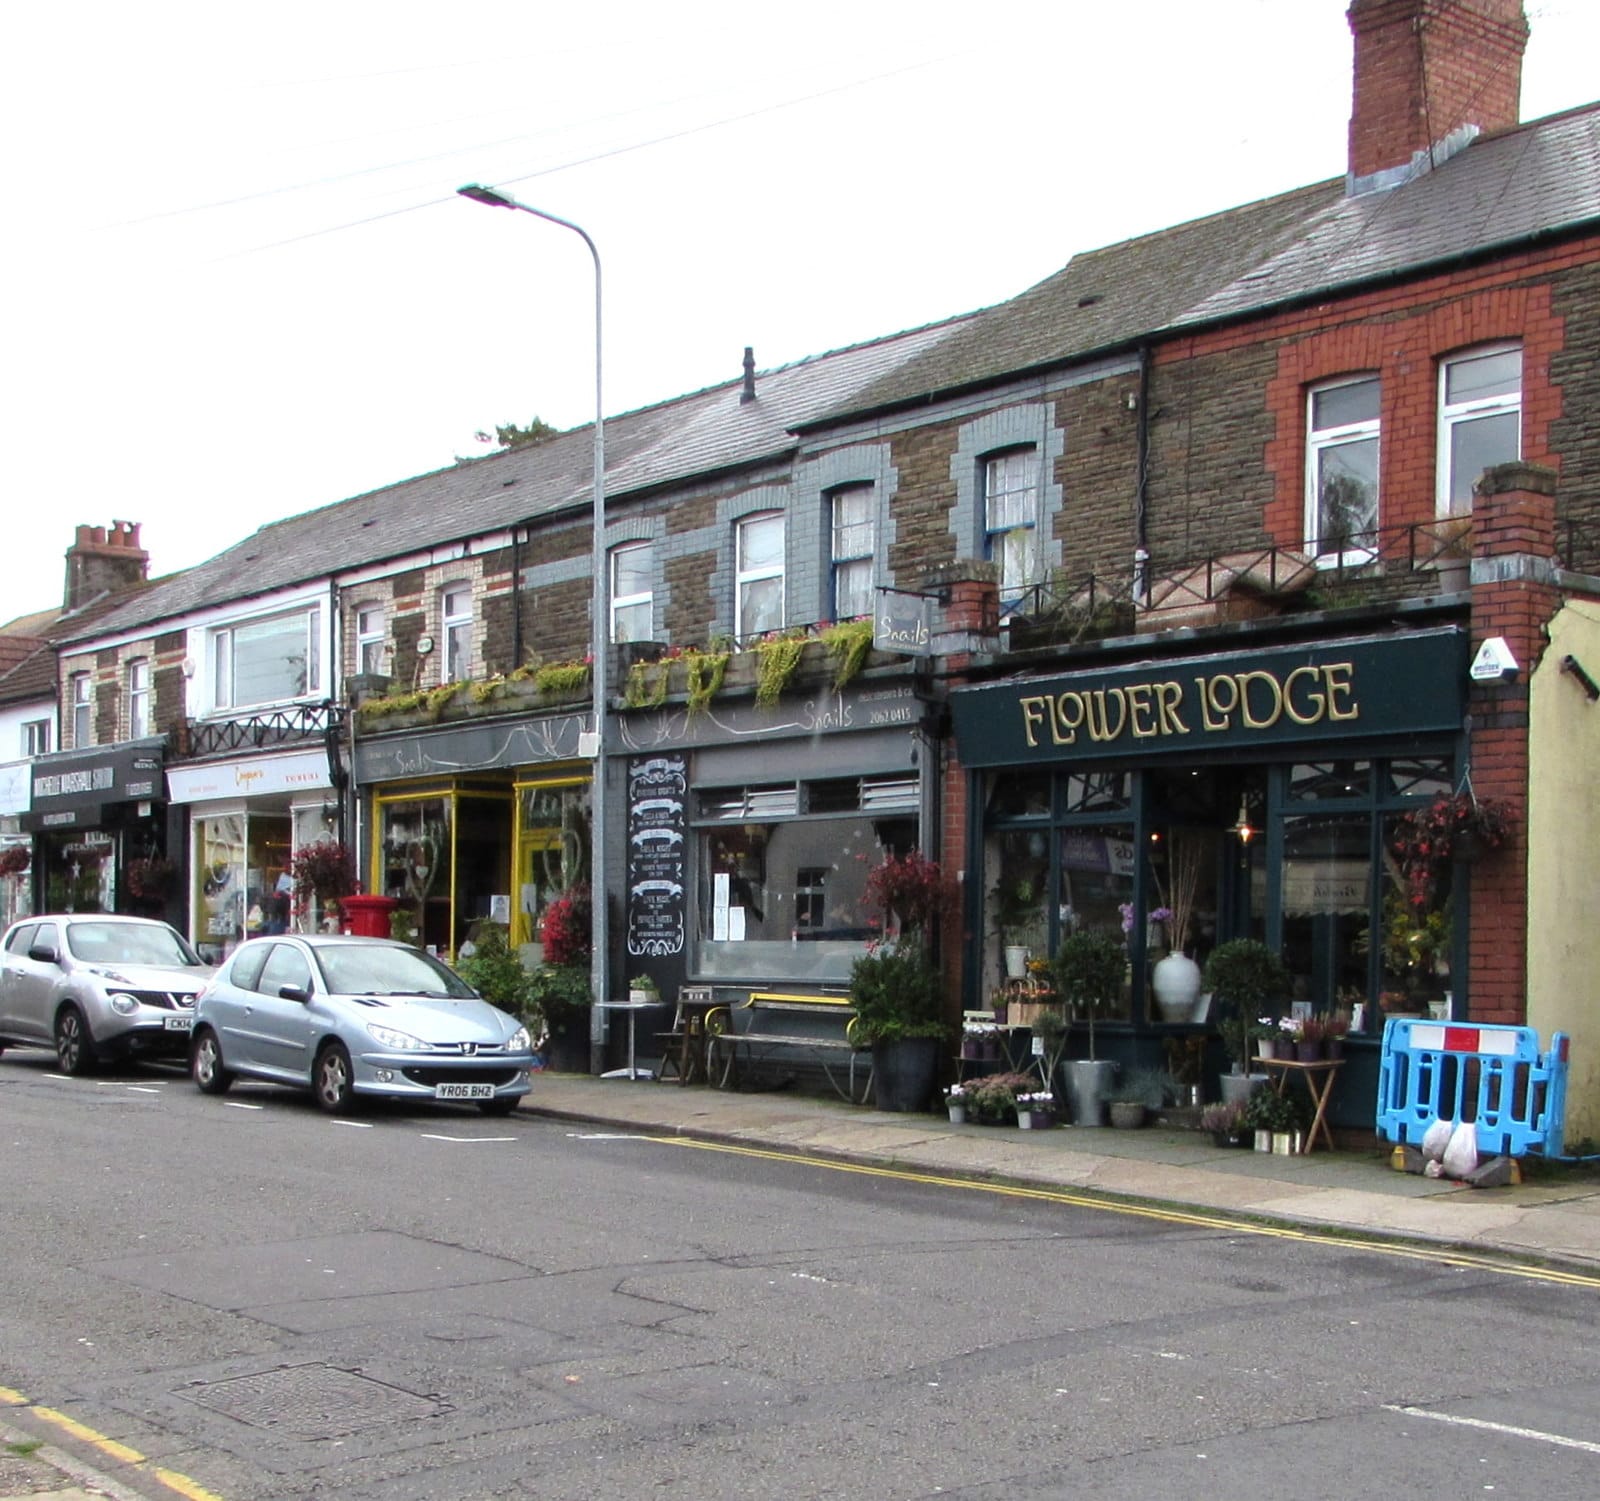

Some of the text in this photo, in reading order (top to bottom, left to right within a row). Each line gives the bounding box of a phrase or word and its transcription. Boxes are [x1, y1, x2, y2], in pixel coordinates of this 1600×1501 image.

[879, 616, 929, 645] Snails
[801, 690, 854, 730] Snails
[1019, 662, 1359, 748] FLOWER LODGE
[440, 1085, 491, 1096] YR06 BHZ
